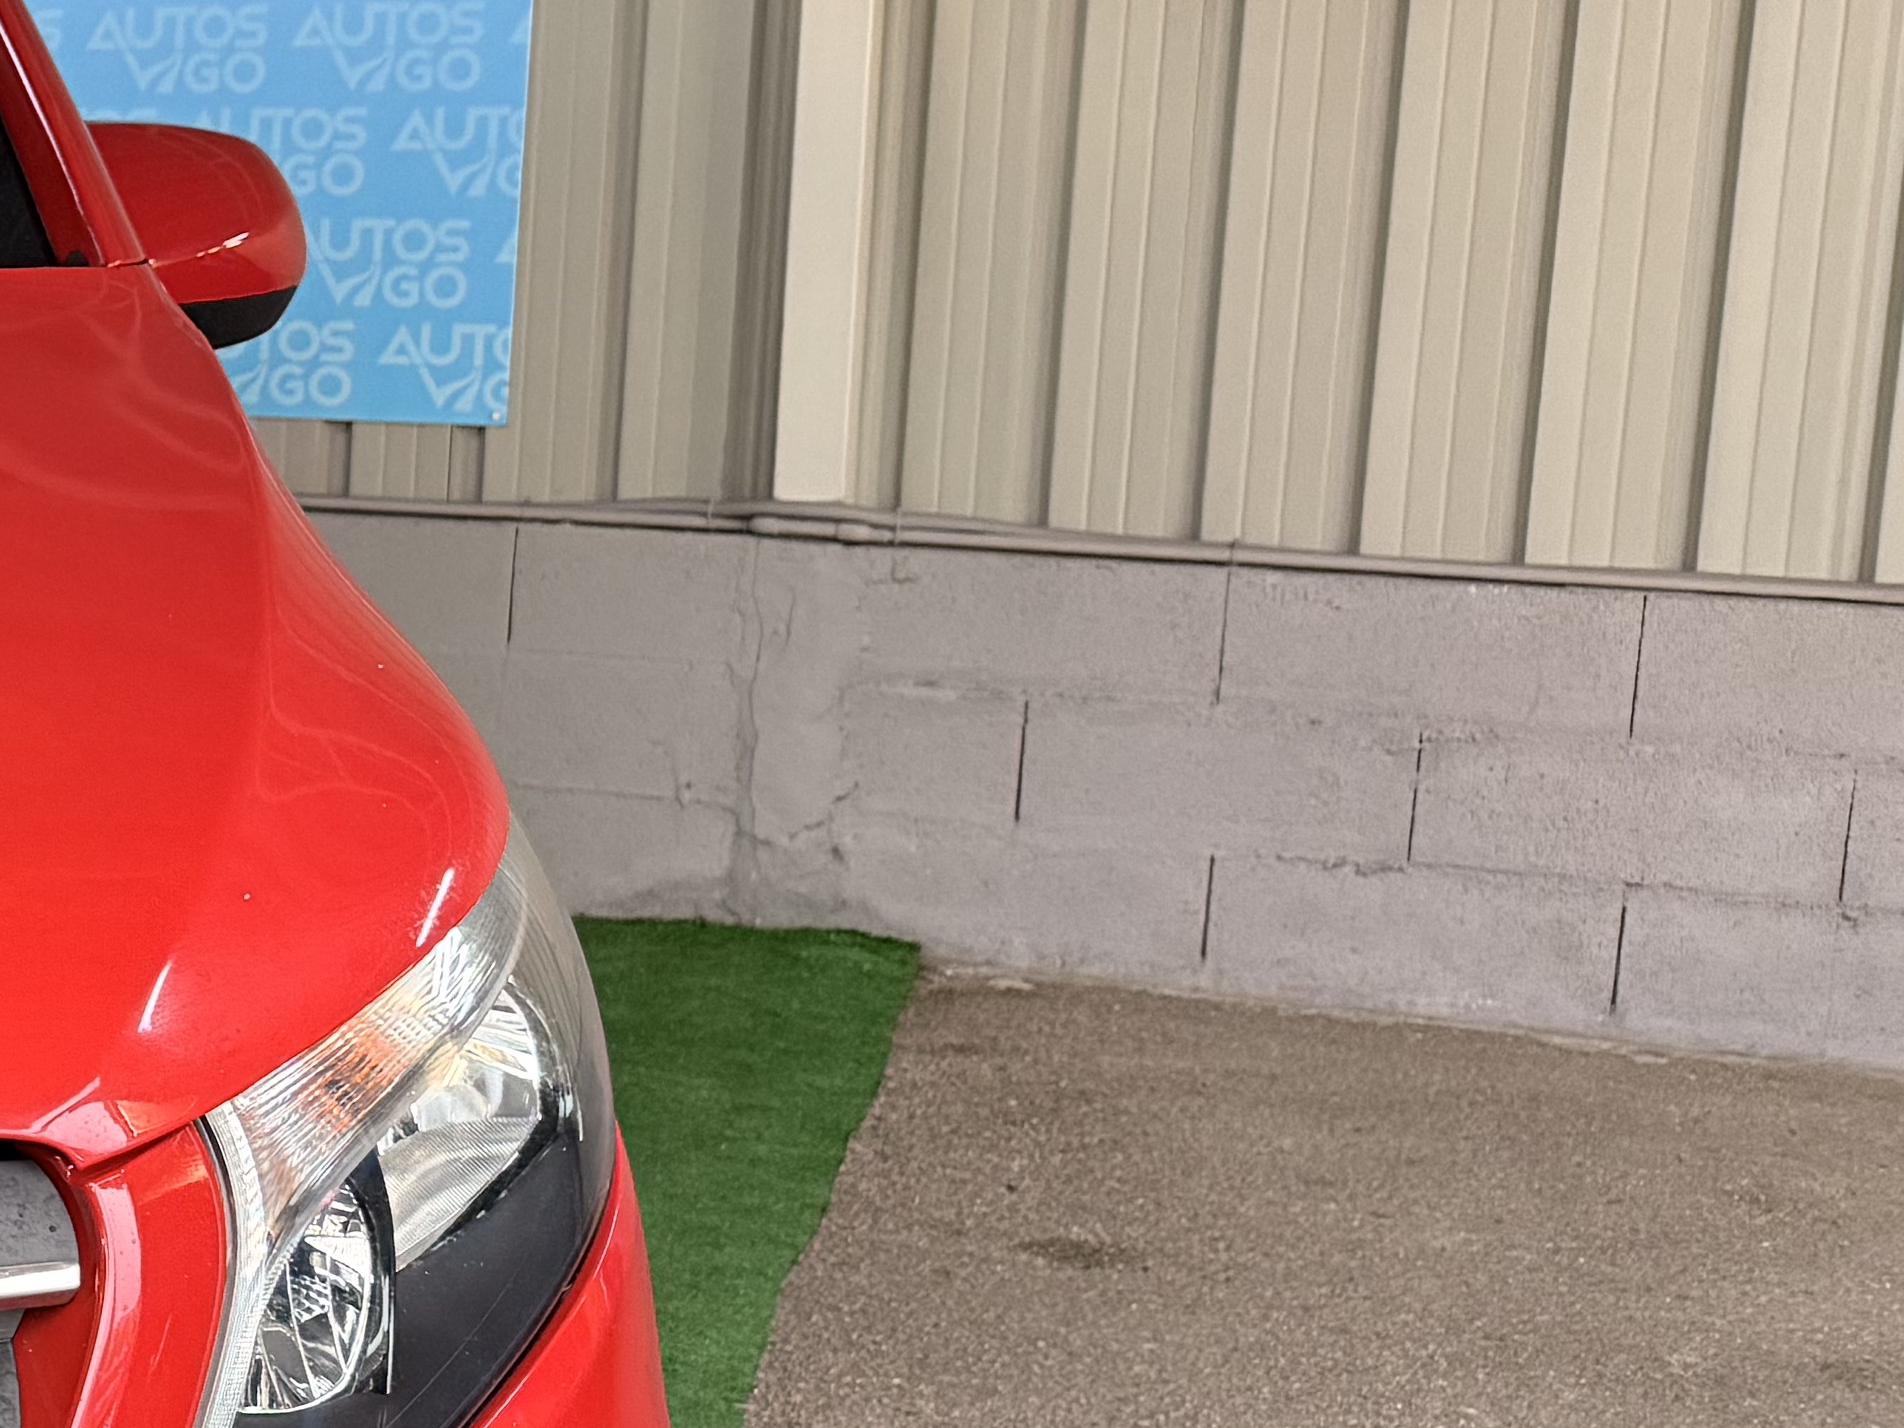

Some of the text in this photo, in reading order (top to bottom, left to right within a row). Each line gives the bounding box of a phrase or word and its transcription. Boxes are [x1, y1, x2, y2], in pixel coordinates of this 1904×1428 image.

[85, 3, 269, 50] AUTOS
[292, 0, 485, 48] AUTOS
[118, 49, 267, 94] VIGO
[327, 46, 482, 93] VIGO
